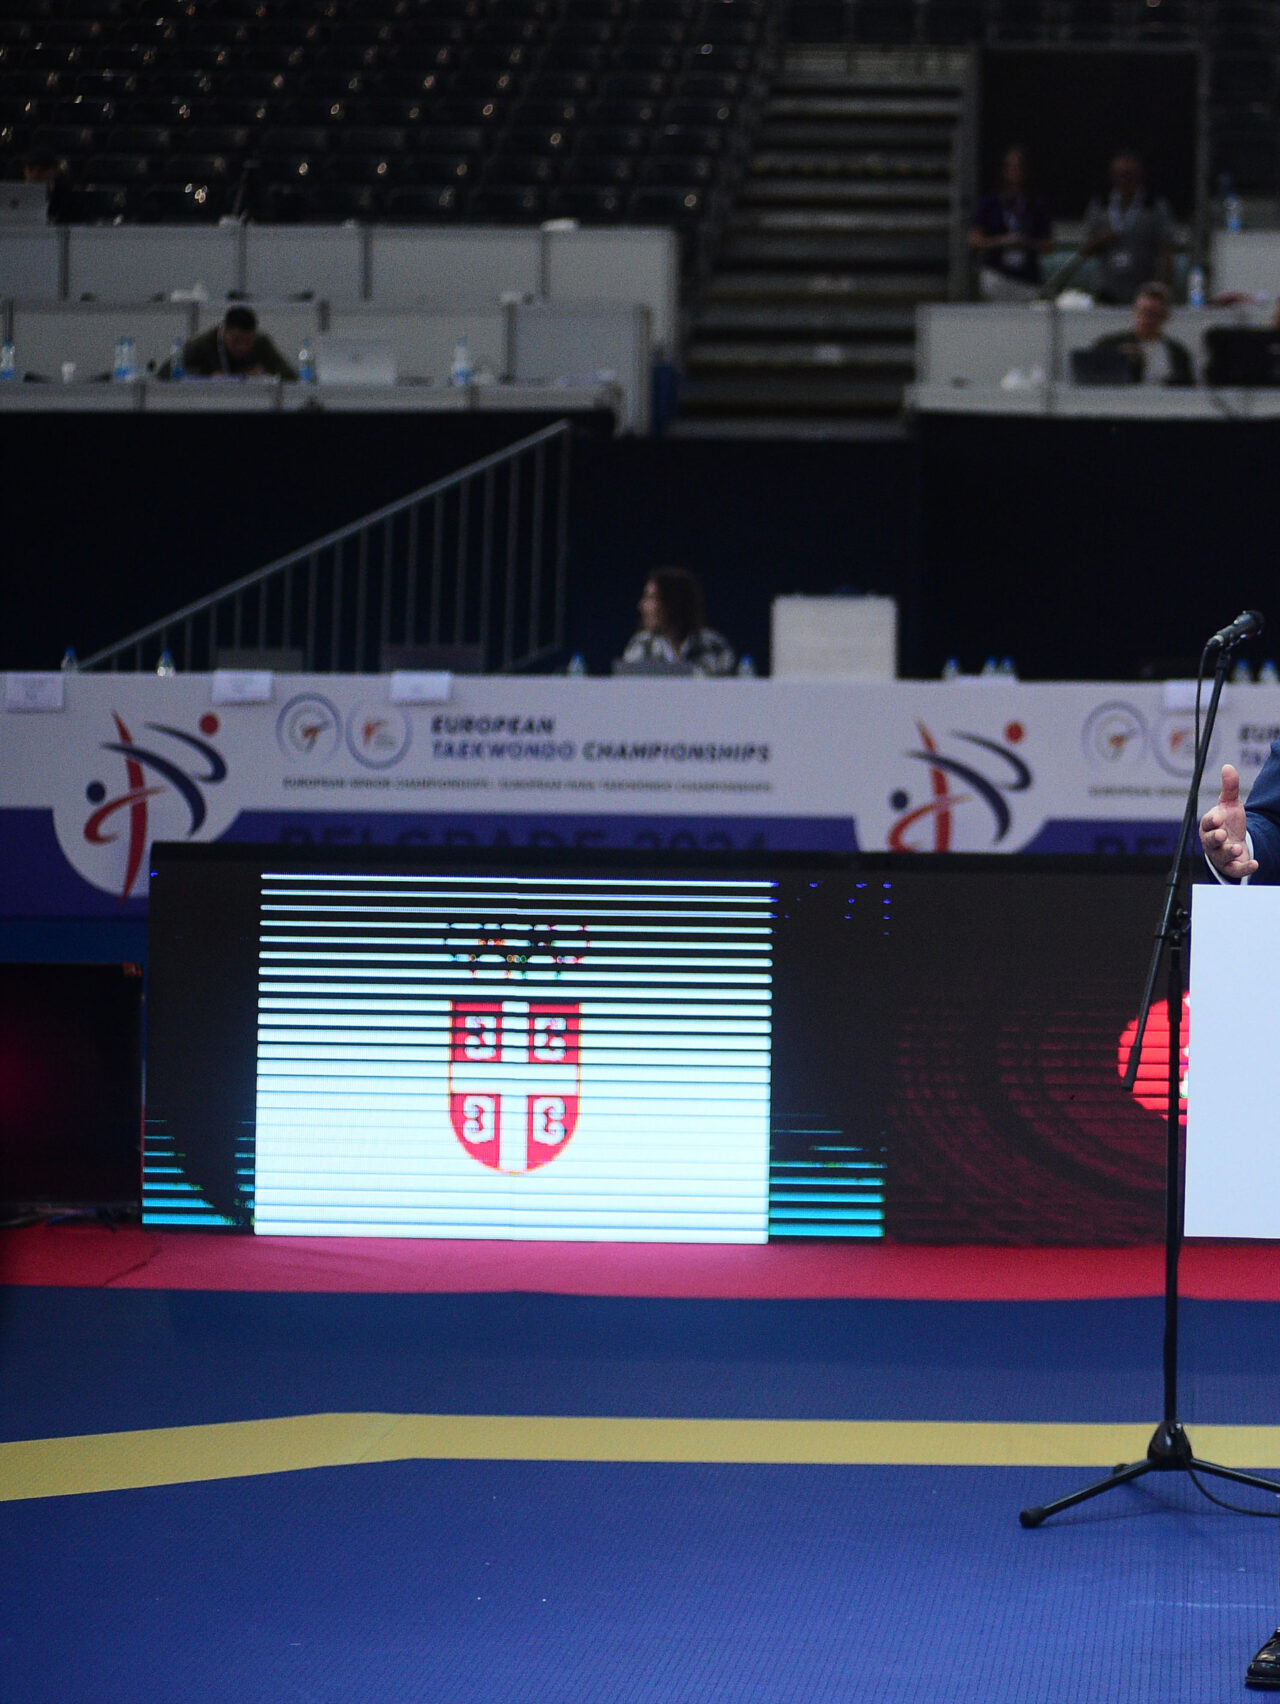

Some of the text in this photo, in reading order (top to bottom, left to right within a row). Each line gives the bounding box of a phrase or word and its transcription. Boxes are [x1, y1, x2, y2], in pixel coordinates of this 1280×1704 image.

[430, 714, 555, 735] EUROPEAN
[431, 740, 771, 763] TAEKWONDO CHAMPIONSHIPS
